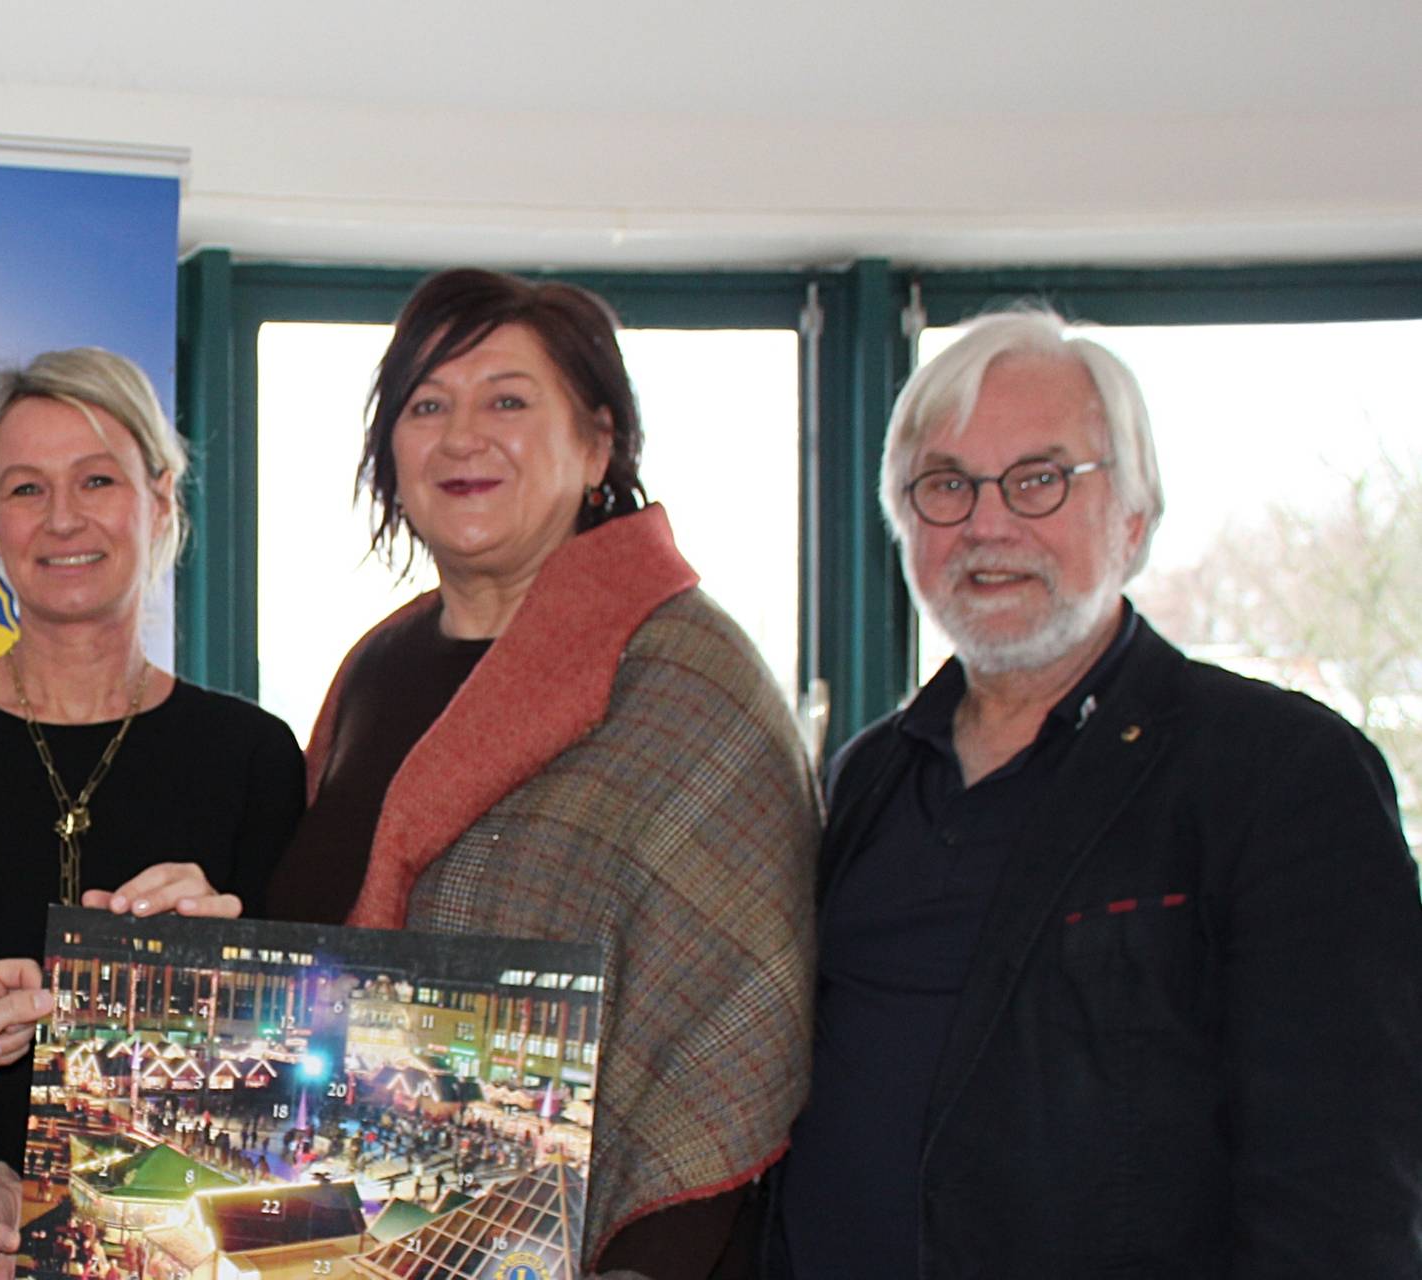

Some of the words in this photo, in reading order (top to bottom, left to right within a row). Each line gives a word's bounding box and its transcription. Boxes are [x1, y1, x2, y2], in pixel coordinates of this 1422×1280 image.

[107, 1003, 124, 1018] 14
[198, 1006, 209, 1018] 4
[333, 1002, 344, 1014] 6
[280, 1016, 295, 1029] 12
[327, 1083, 348, 1098] 20
[272, 1104, 289, 1118] 18
[98, 1163, 108, 1177] 2
[185, 1169, 195, 1184] 8
[261, 1199, 281, 1215] 22
[312, 1260, 331, 1275] 23
